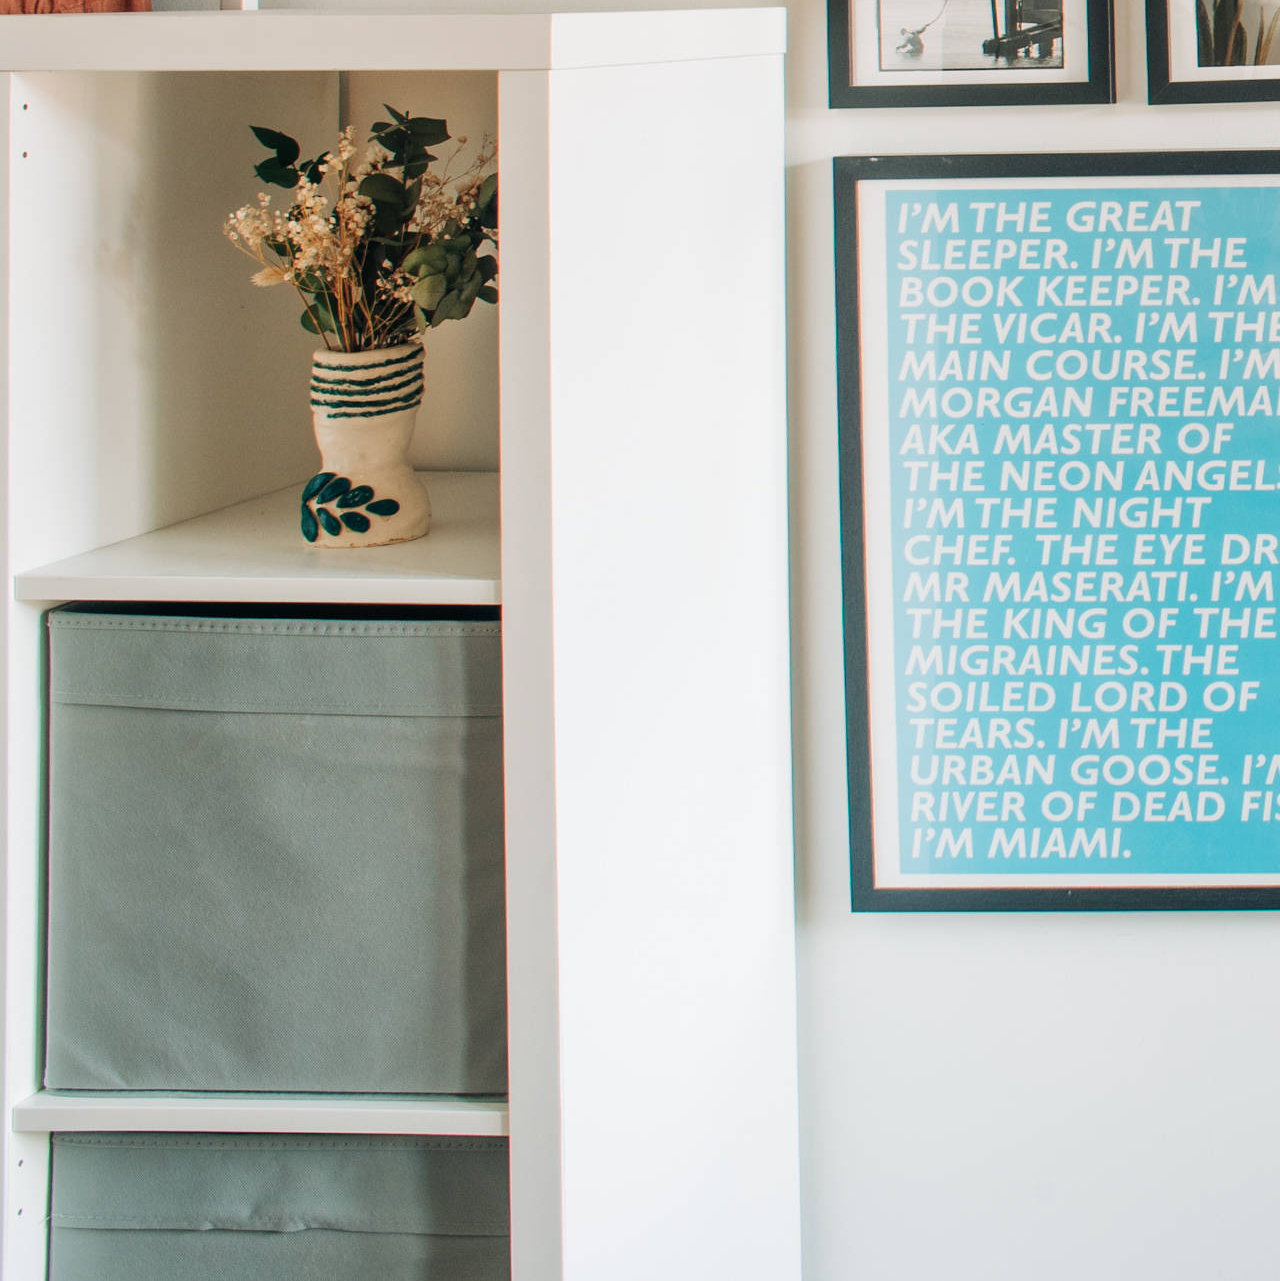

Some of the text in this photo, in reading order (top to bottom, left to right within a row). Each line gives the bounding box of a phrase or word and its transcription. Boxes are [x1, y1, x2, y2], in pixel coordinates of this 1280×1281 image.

[970, 202, 1051, 232] THE
[1066, 201, 1201, 232] GREAT
[897, 239, 1078, 270] SLEEPER.
[1164, 238, 1247, 268] THE
[899, 276, 1024, 307] BOOK
[1037, 275, 1200, 306] KEEPER.
[900, 314, 981, 344] THE
[993, 312, 1121, 344] VICAR.
[898, 350, 1010, 382] MAIN
[1026, 349, 1205, 381] COURSE.
[898, 387, 1093, 418] MORGAN
[899, 423, 1233, 455] AKA MASTER OF
[902, 461, 984, 491] THE
[1000, 461, 1124, 491] NEON
[976, 498, 1056, 528] THE
[1072, 497, 1211, 528] NIGHT
[904, 535, 1015, 565] CHEF.
[1036, 534, 1118, 565] THE
[1133, 534, 1205, 565] EYE
[902, 572, 968, 602] MR
[983, 571, 1197, 602] MASERATI.
[906, 608, 1276, 639] THE KING OF THE
[904, 645, 1239, 676] MIGRAINES. THE
[905, 682, 1259, 712] SOILED LORD OF
[909, 718, 1044, 748] TEARS.
[1130, 718, 1213, 748] THE
[910, 755, 1055, 785] URBAN
[1071, 755, 1228, 786] GOOSE.
[910, 792, 1025, 822] RIVER
[1042, 791, 1097, 822] OF
[1112, 792, 1225, 822] DEAD
[987, 828, 1131, 858] MIAMI.
